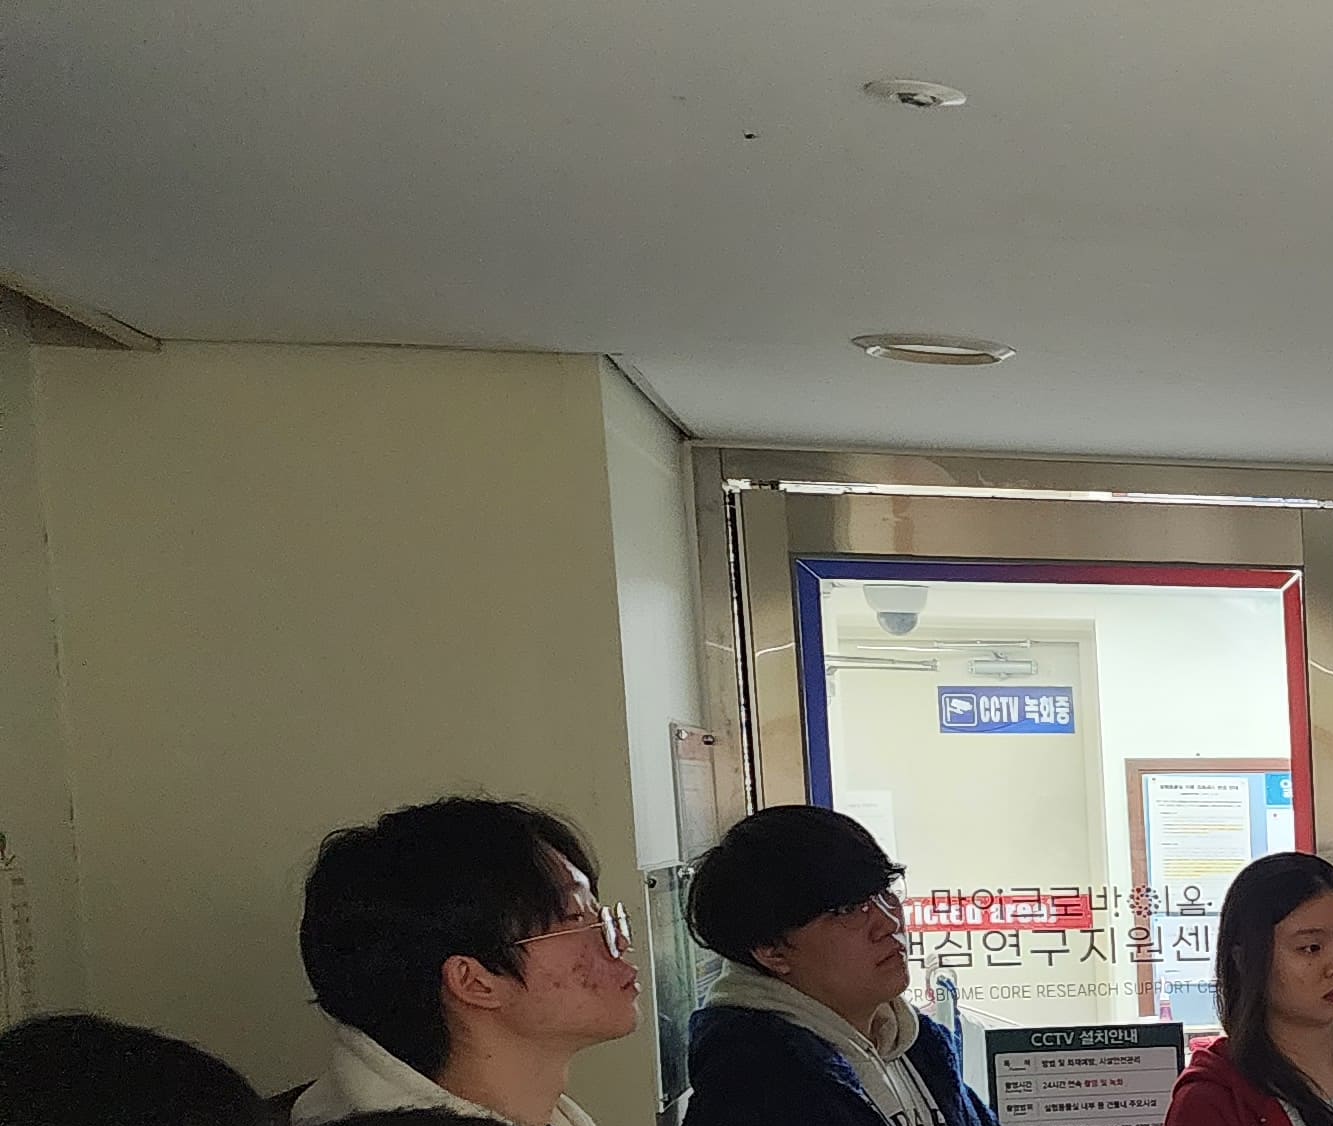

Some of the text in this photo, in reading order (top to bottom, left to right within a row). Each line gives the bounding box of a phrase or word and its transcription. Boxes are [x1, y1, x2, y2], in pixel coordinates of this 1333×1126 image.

[979, 695, 1072, 725] CCTV 녹화중
[989, 984, 1031, 1000] CORE
[1036, 982, 1119, 998] RESEARCH
[1123, 980, 1193, 995] SUPPORT
[1030, 1028, 1139, 1047] CCTV 설치안내
